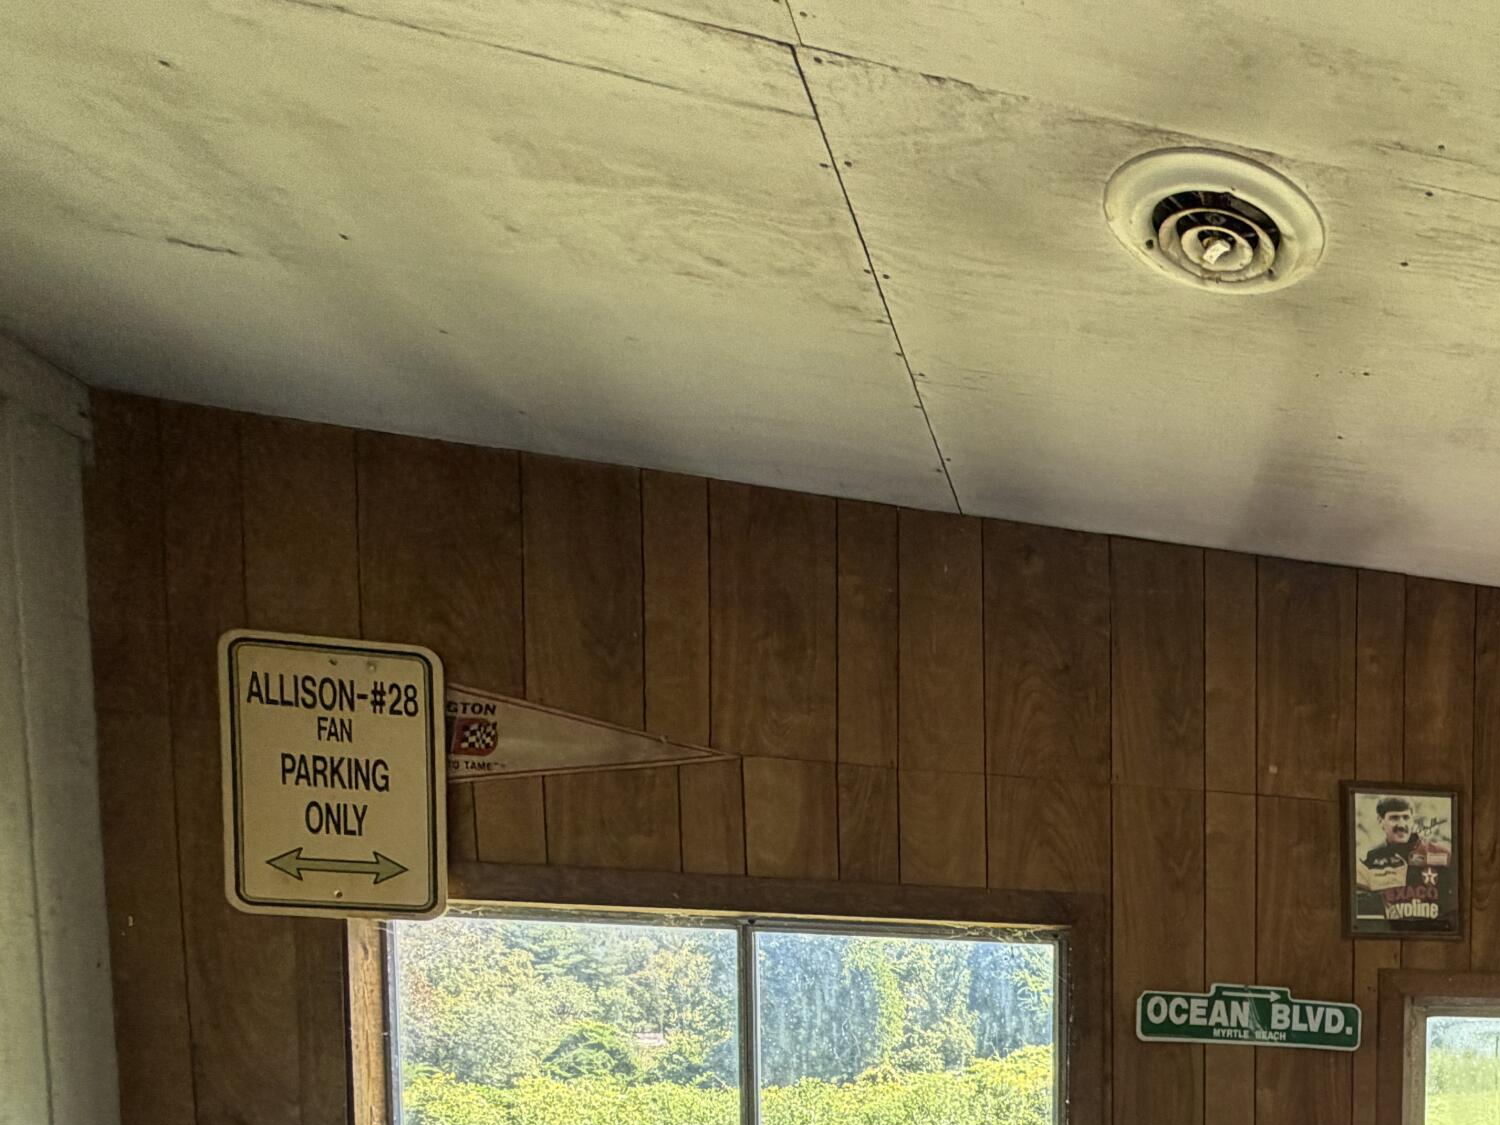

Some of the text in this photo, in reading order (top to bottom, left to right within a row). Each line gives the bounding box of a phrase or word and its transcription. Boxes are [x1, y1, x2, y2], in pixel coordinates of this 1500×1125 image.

[247, 671, 419, 717] ALLISON-#28
[446, 701, 497, 716] GTON
[317, 716, 353, 743] FAN
[281, 753, 390, 793] PARKING
[305, 801, 368, 837] ONLY
[1146, 996, 1353, 1035] OCEAN BLVD.
[1213, 1028, 1287, 1041] MYRTLE BEACH
